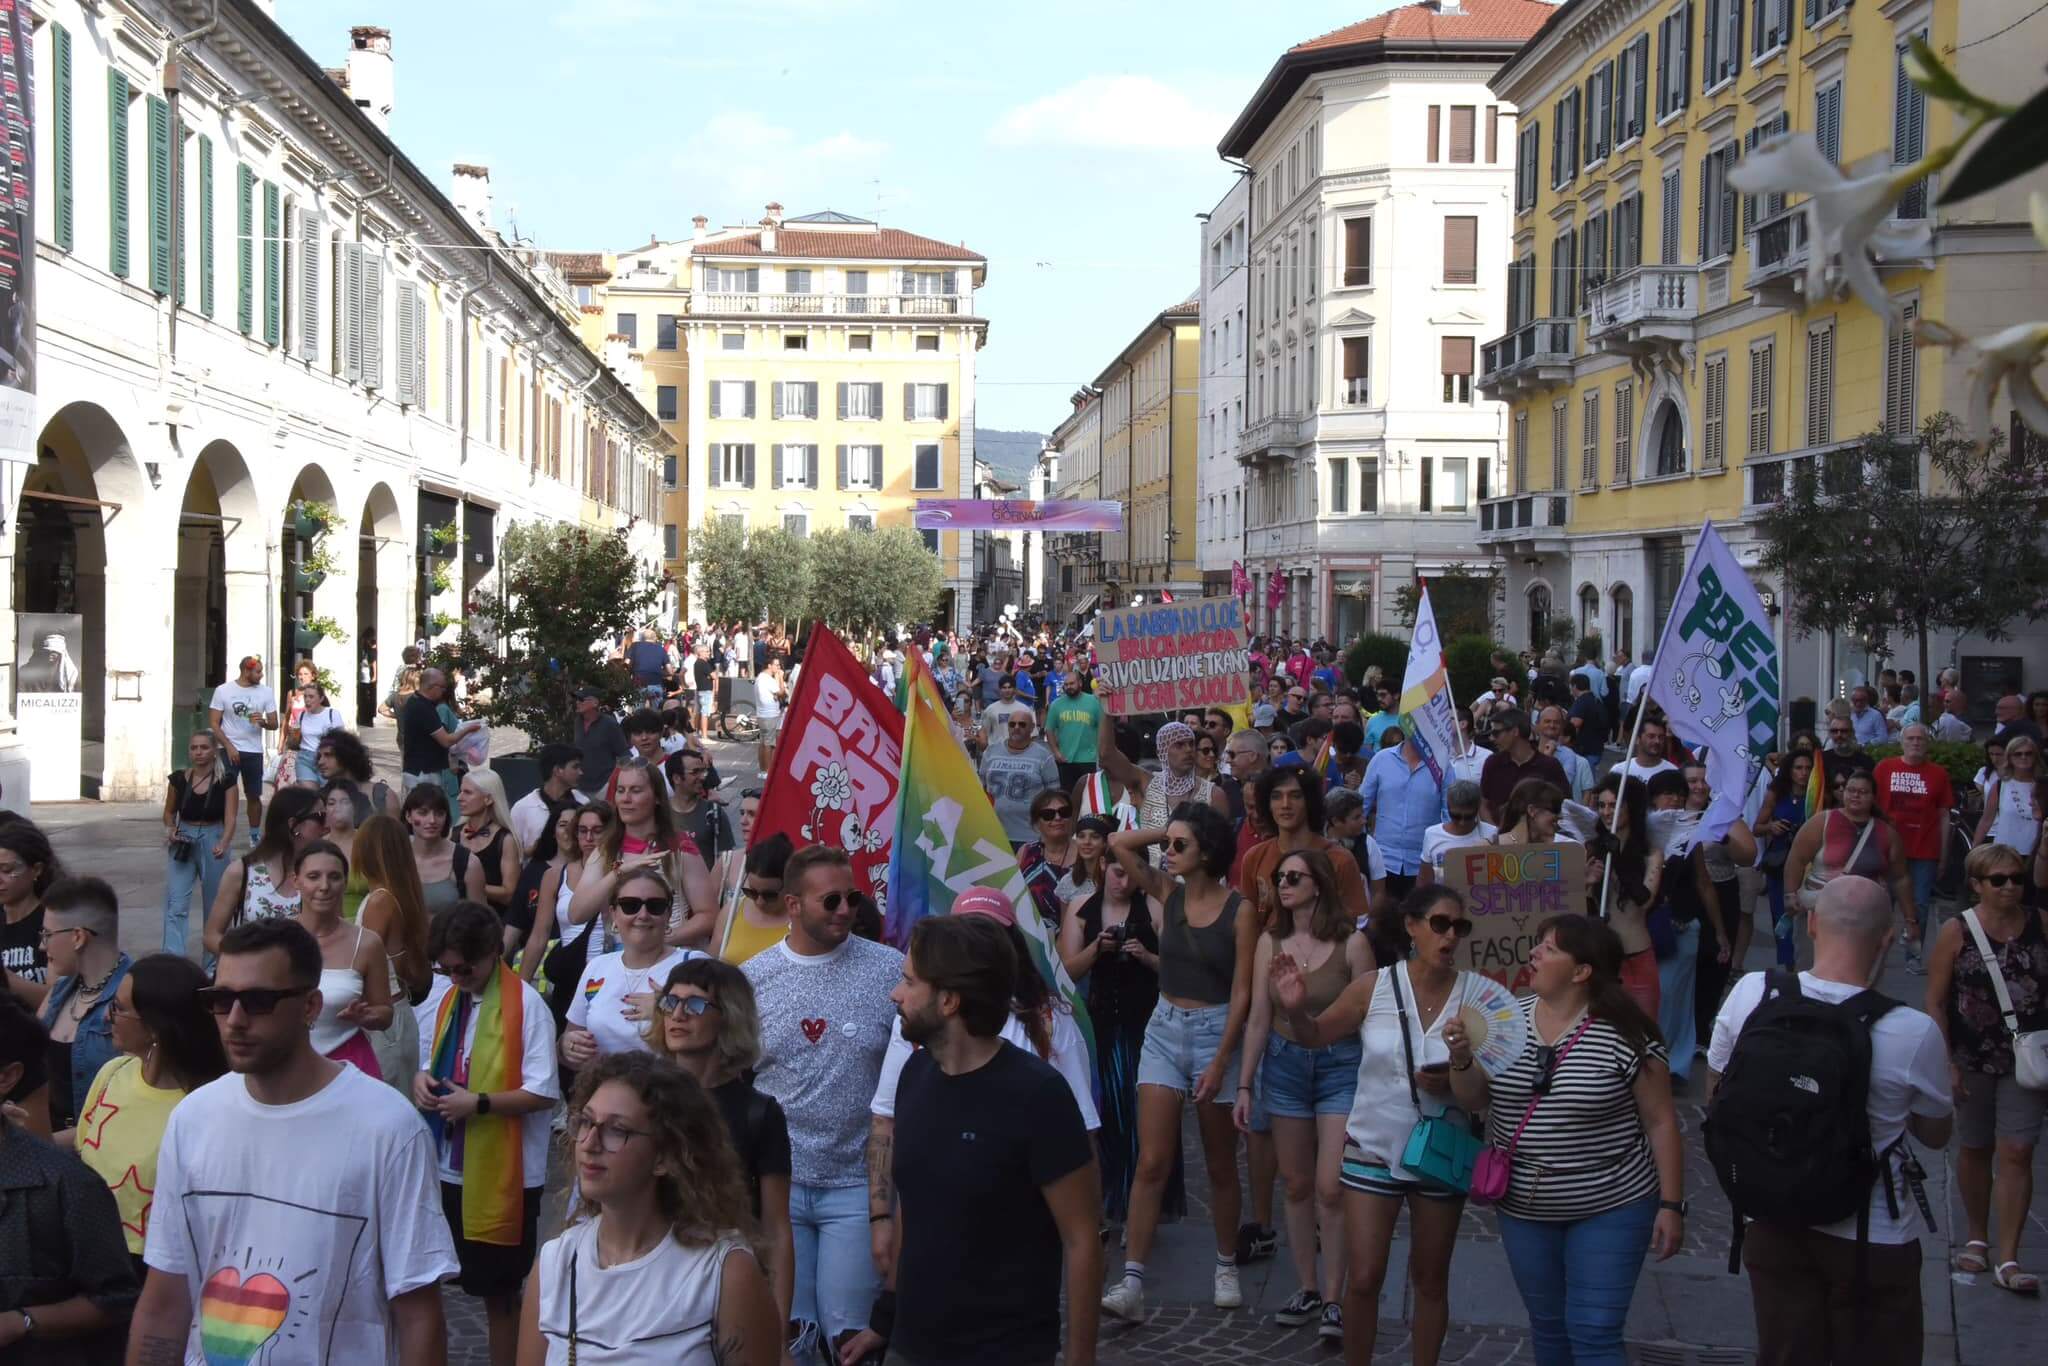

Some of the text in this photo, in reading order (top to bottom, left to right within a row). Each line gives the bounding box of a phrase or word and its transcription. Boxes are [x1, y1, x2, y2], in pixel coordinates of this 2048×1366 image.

[1100, 614, 1124, 642] LA
[1127, 608, 1181, 638] RABBIA
[1183, 607, 1198, 634] DI
[1118, 628, 1239, 662] BRUCIA ANCORA
[1098, 649, 1250, 689] RIVOLUZIONE TRANS
[21, 699, 78, 708] MICALIZZI
[1108, 673, 1246, 713] IN OGNI SCUOLA
[1890, 771, 1921, 780] ALCUNE
[1890, 778, 1926, 788] PERSONE
[1890, 784, 1911, 793] SONO
[1469, 879, 1570, 916] SEMPRE
